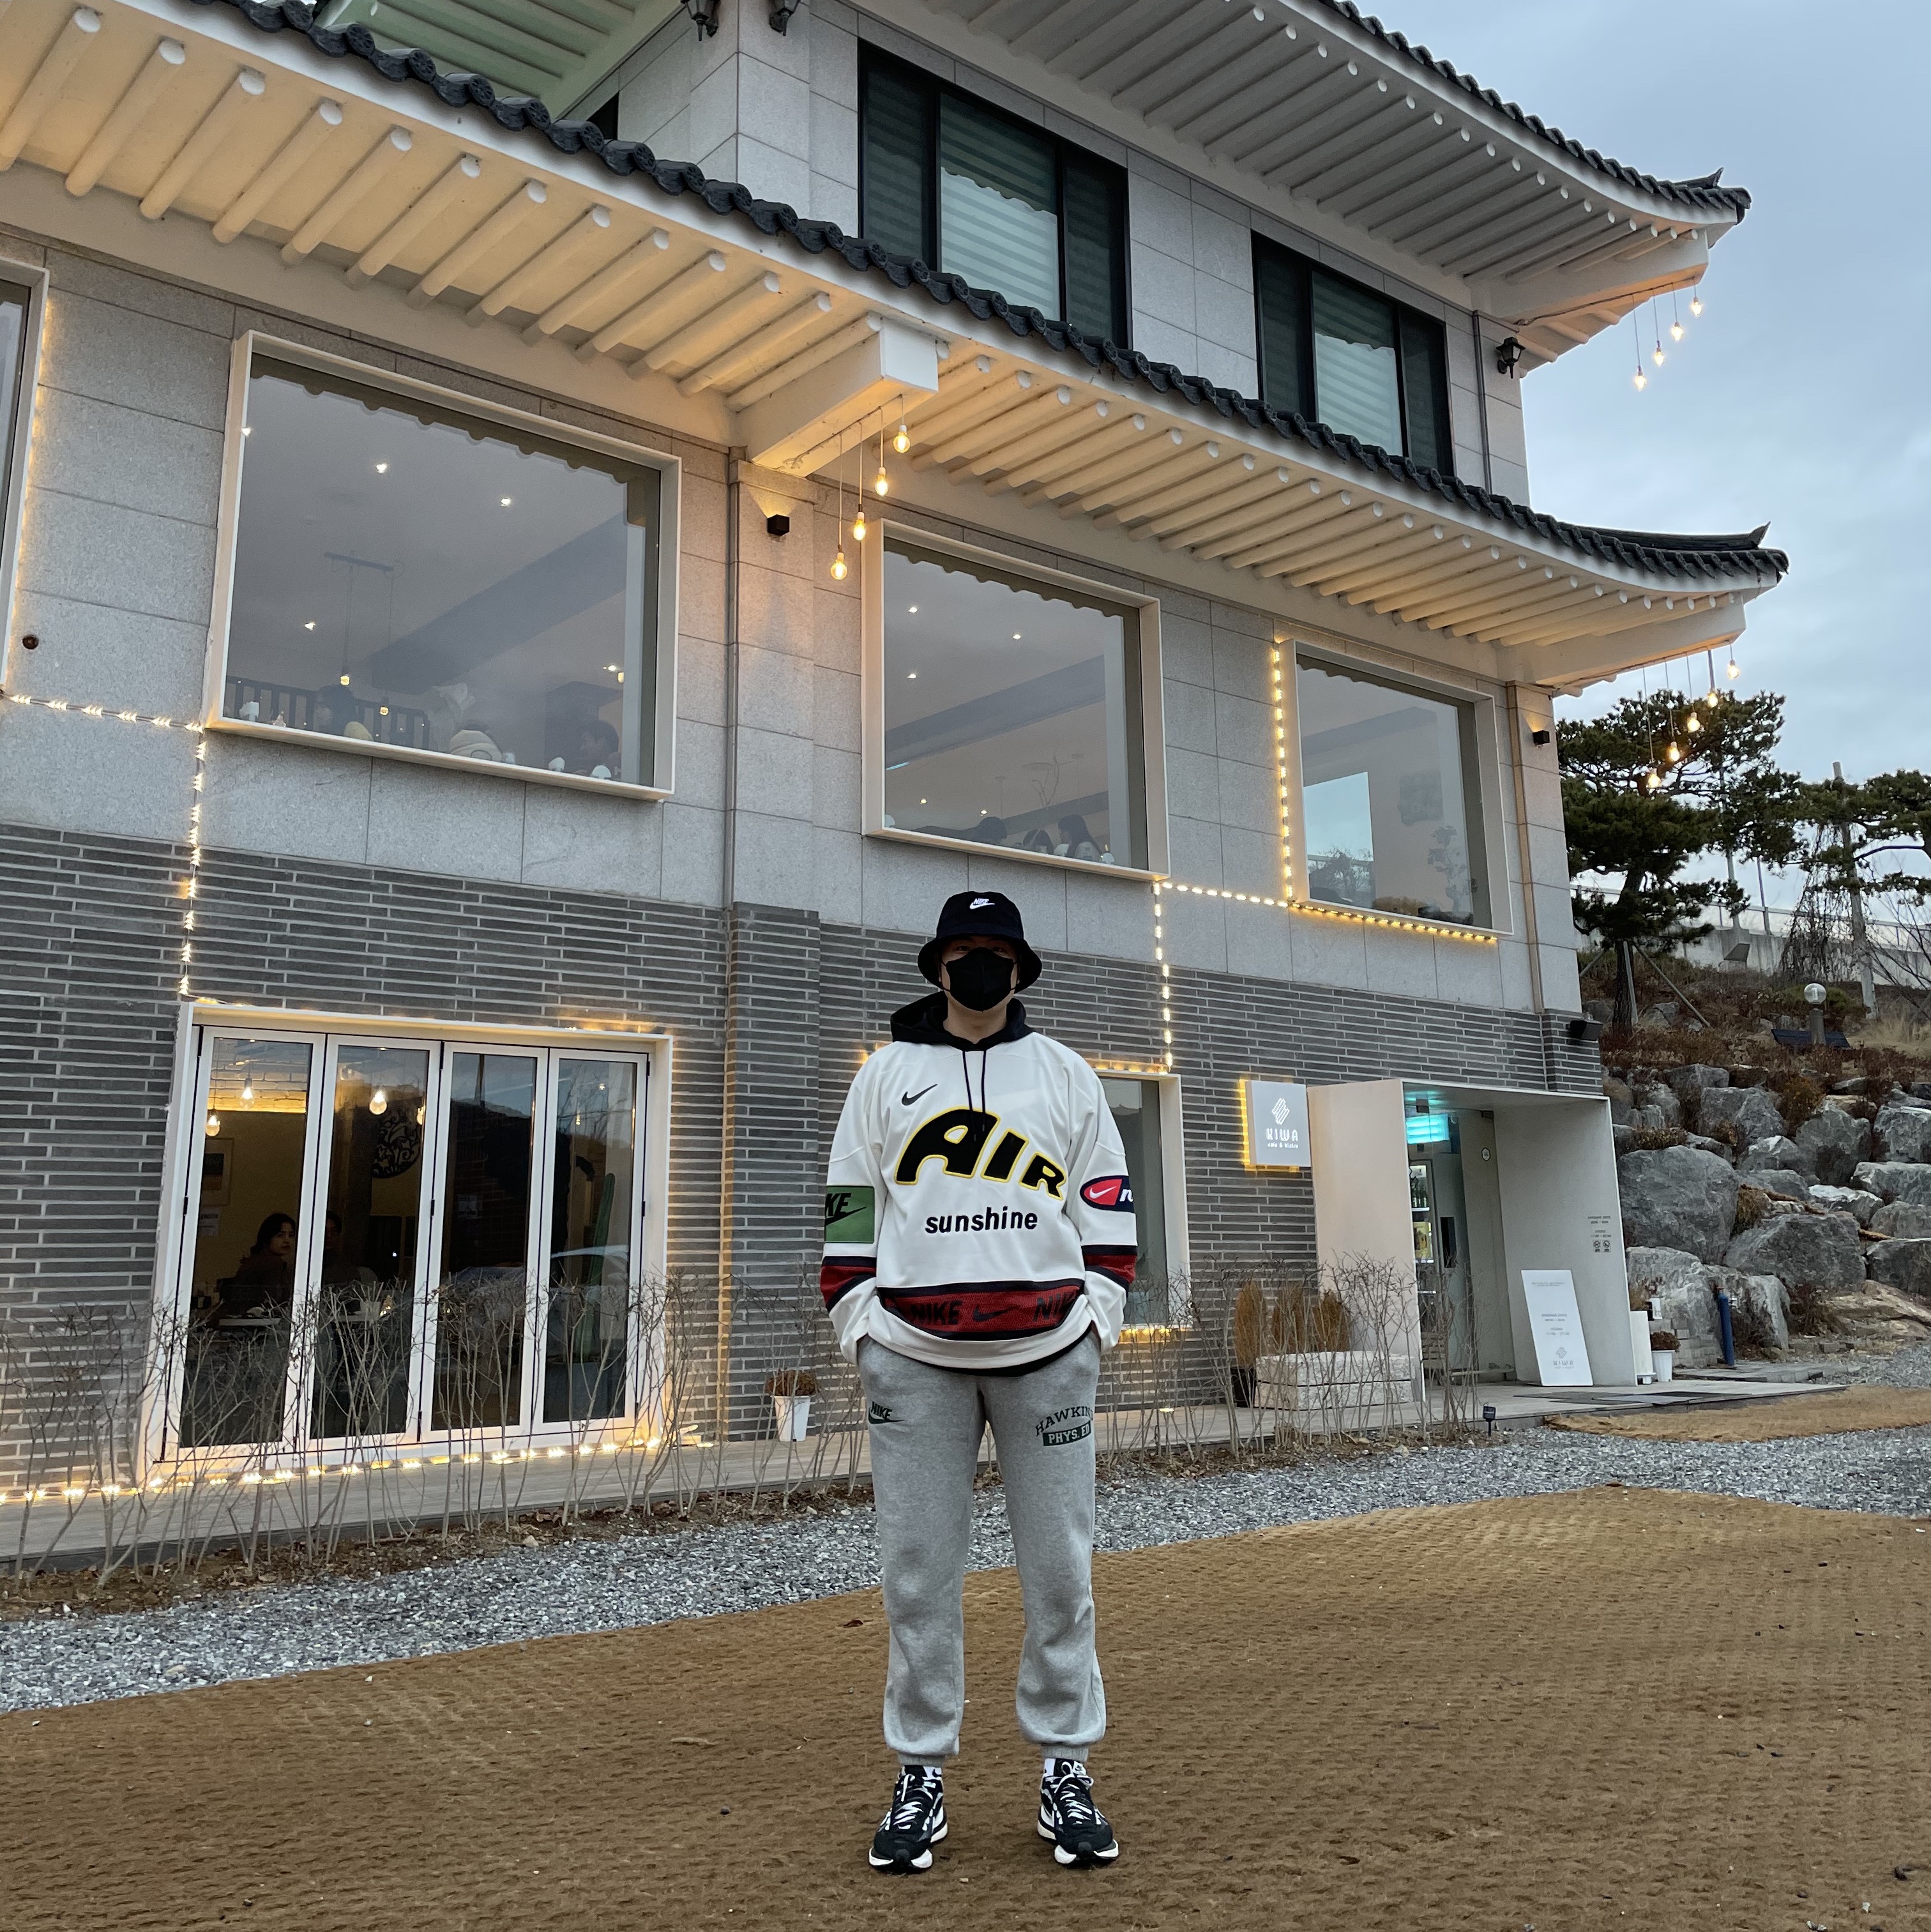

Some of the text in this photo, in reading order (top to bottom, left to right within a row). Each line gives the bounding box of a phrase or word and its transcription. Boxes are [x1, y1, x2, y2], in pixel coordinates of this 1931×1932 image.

[1266, 1128, 1299, 1142] KIWA
[894, 1106, 1067, 1201] AIR
[925, 1206, 1038, 1234] sunshine
[909, 1299, 963, 1325] NIKE
[871, 1401, 893, 1420] NIKE
[1048, 1429, 1080, 1444] PHYS.
